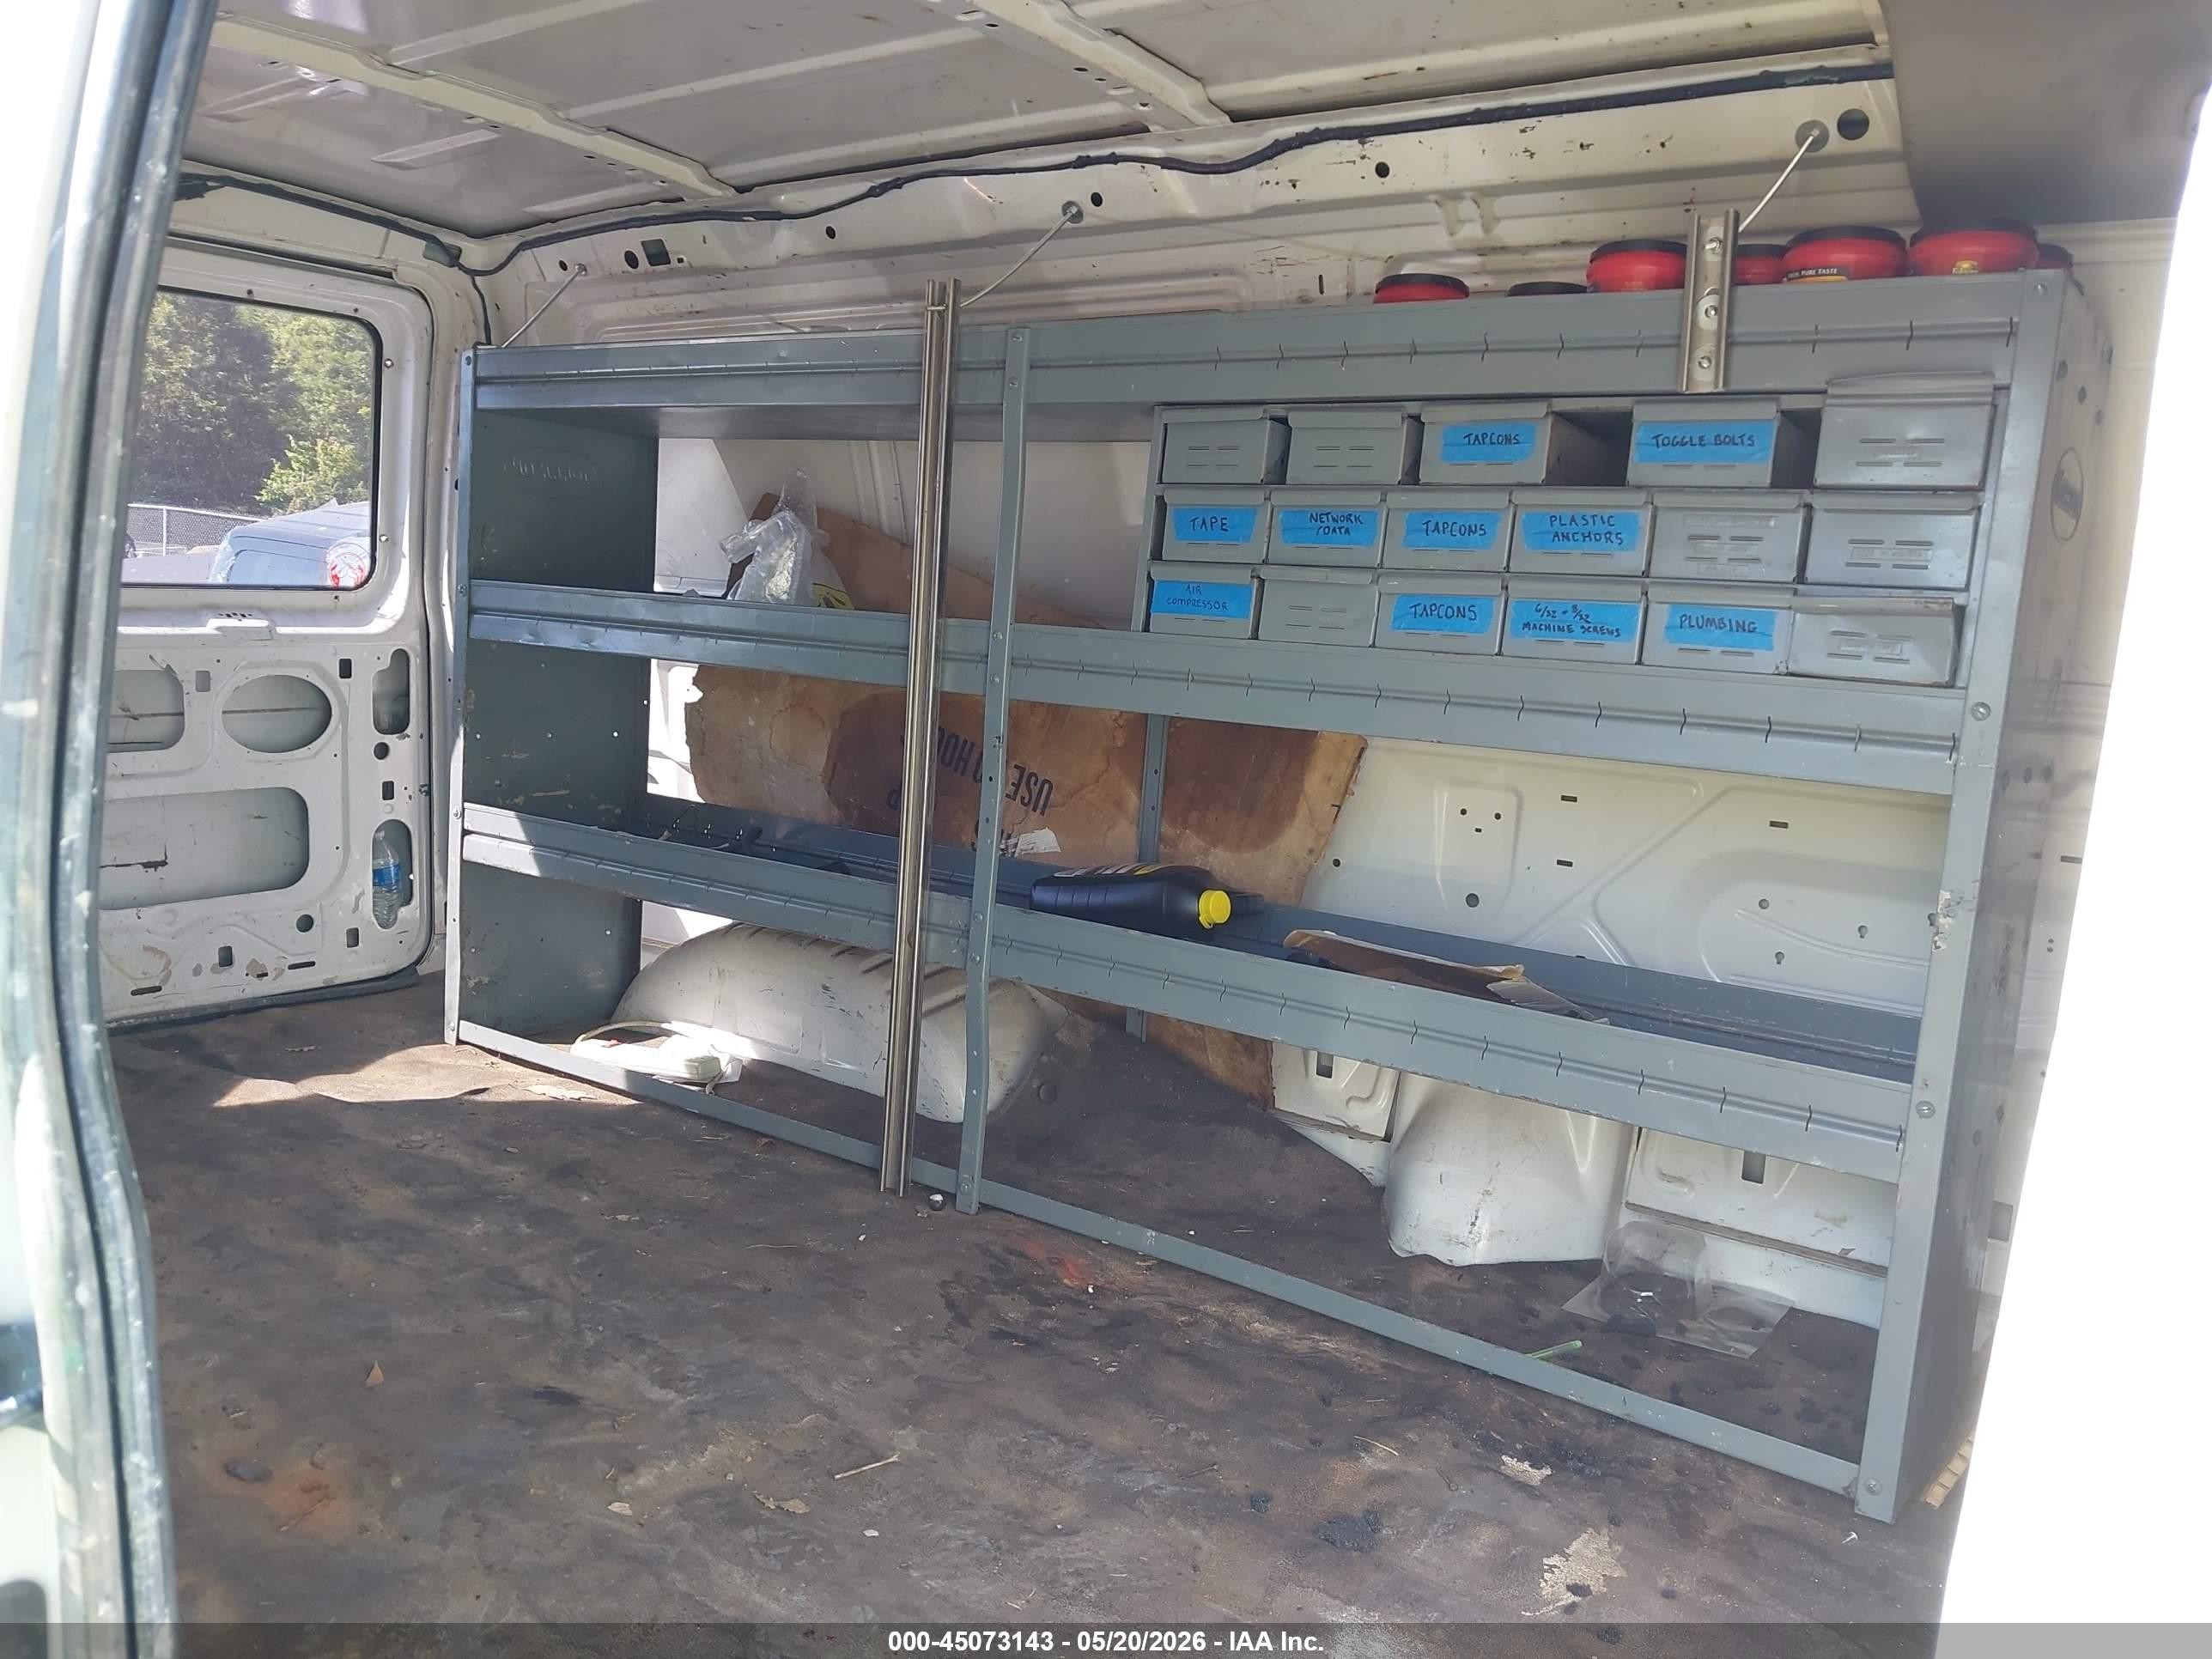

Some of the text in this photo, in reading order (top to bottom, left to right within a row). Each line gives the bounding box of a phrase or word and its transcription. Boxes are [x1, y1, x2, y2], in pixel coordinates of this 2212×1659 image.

[1463, 432, 1521, 446] TAPCONS
[1651, 433, 1755, 448] TOGGLE BOLTS
[1189, 516, 1229, 532] TAPE
[1310, 512, 1364, 525] NETWORK
[1549, 514, 1615, 527] PLASTIC
[1422, 520, 1487, 537] TAPCONS
[1552, 531, 1624, 545] ANCHORS
[1185, 584, 1202, 595] AIR
[1409, 603, 1478, 621] TAPCONS
[1522, 621, 1621, 637] MACHINE SCREWS
[1680, 613, 1758, 633] PLUMBING
[1005, 763, 1054, 817] USE
